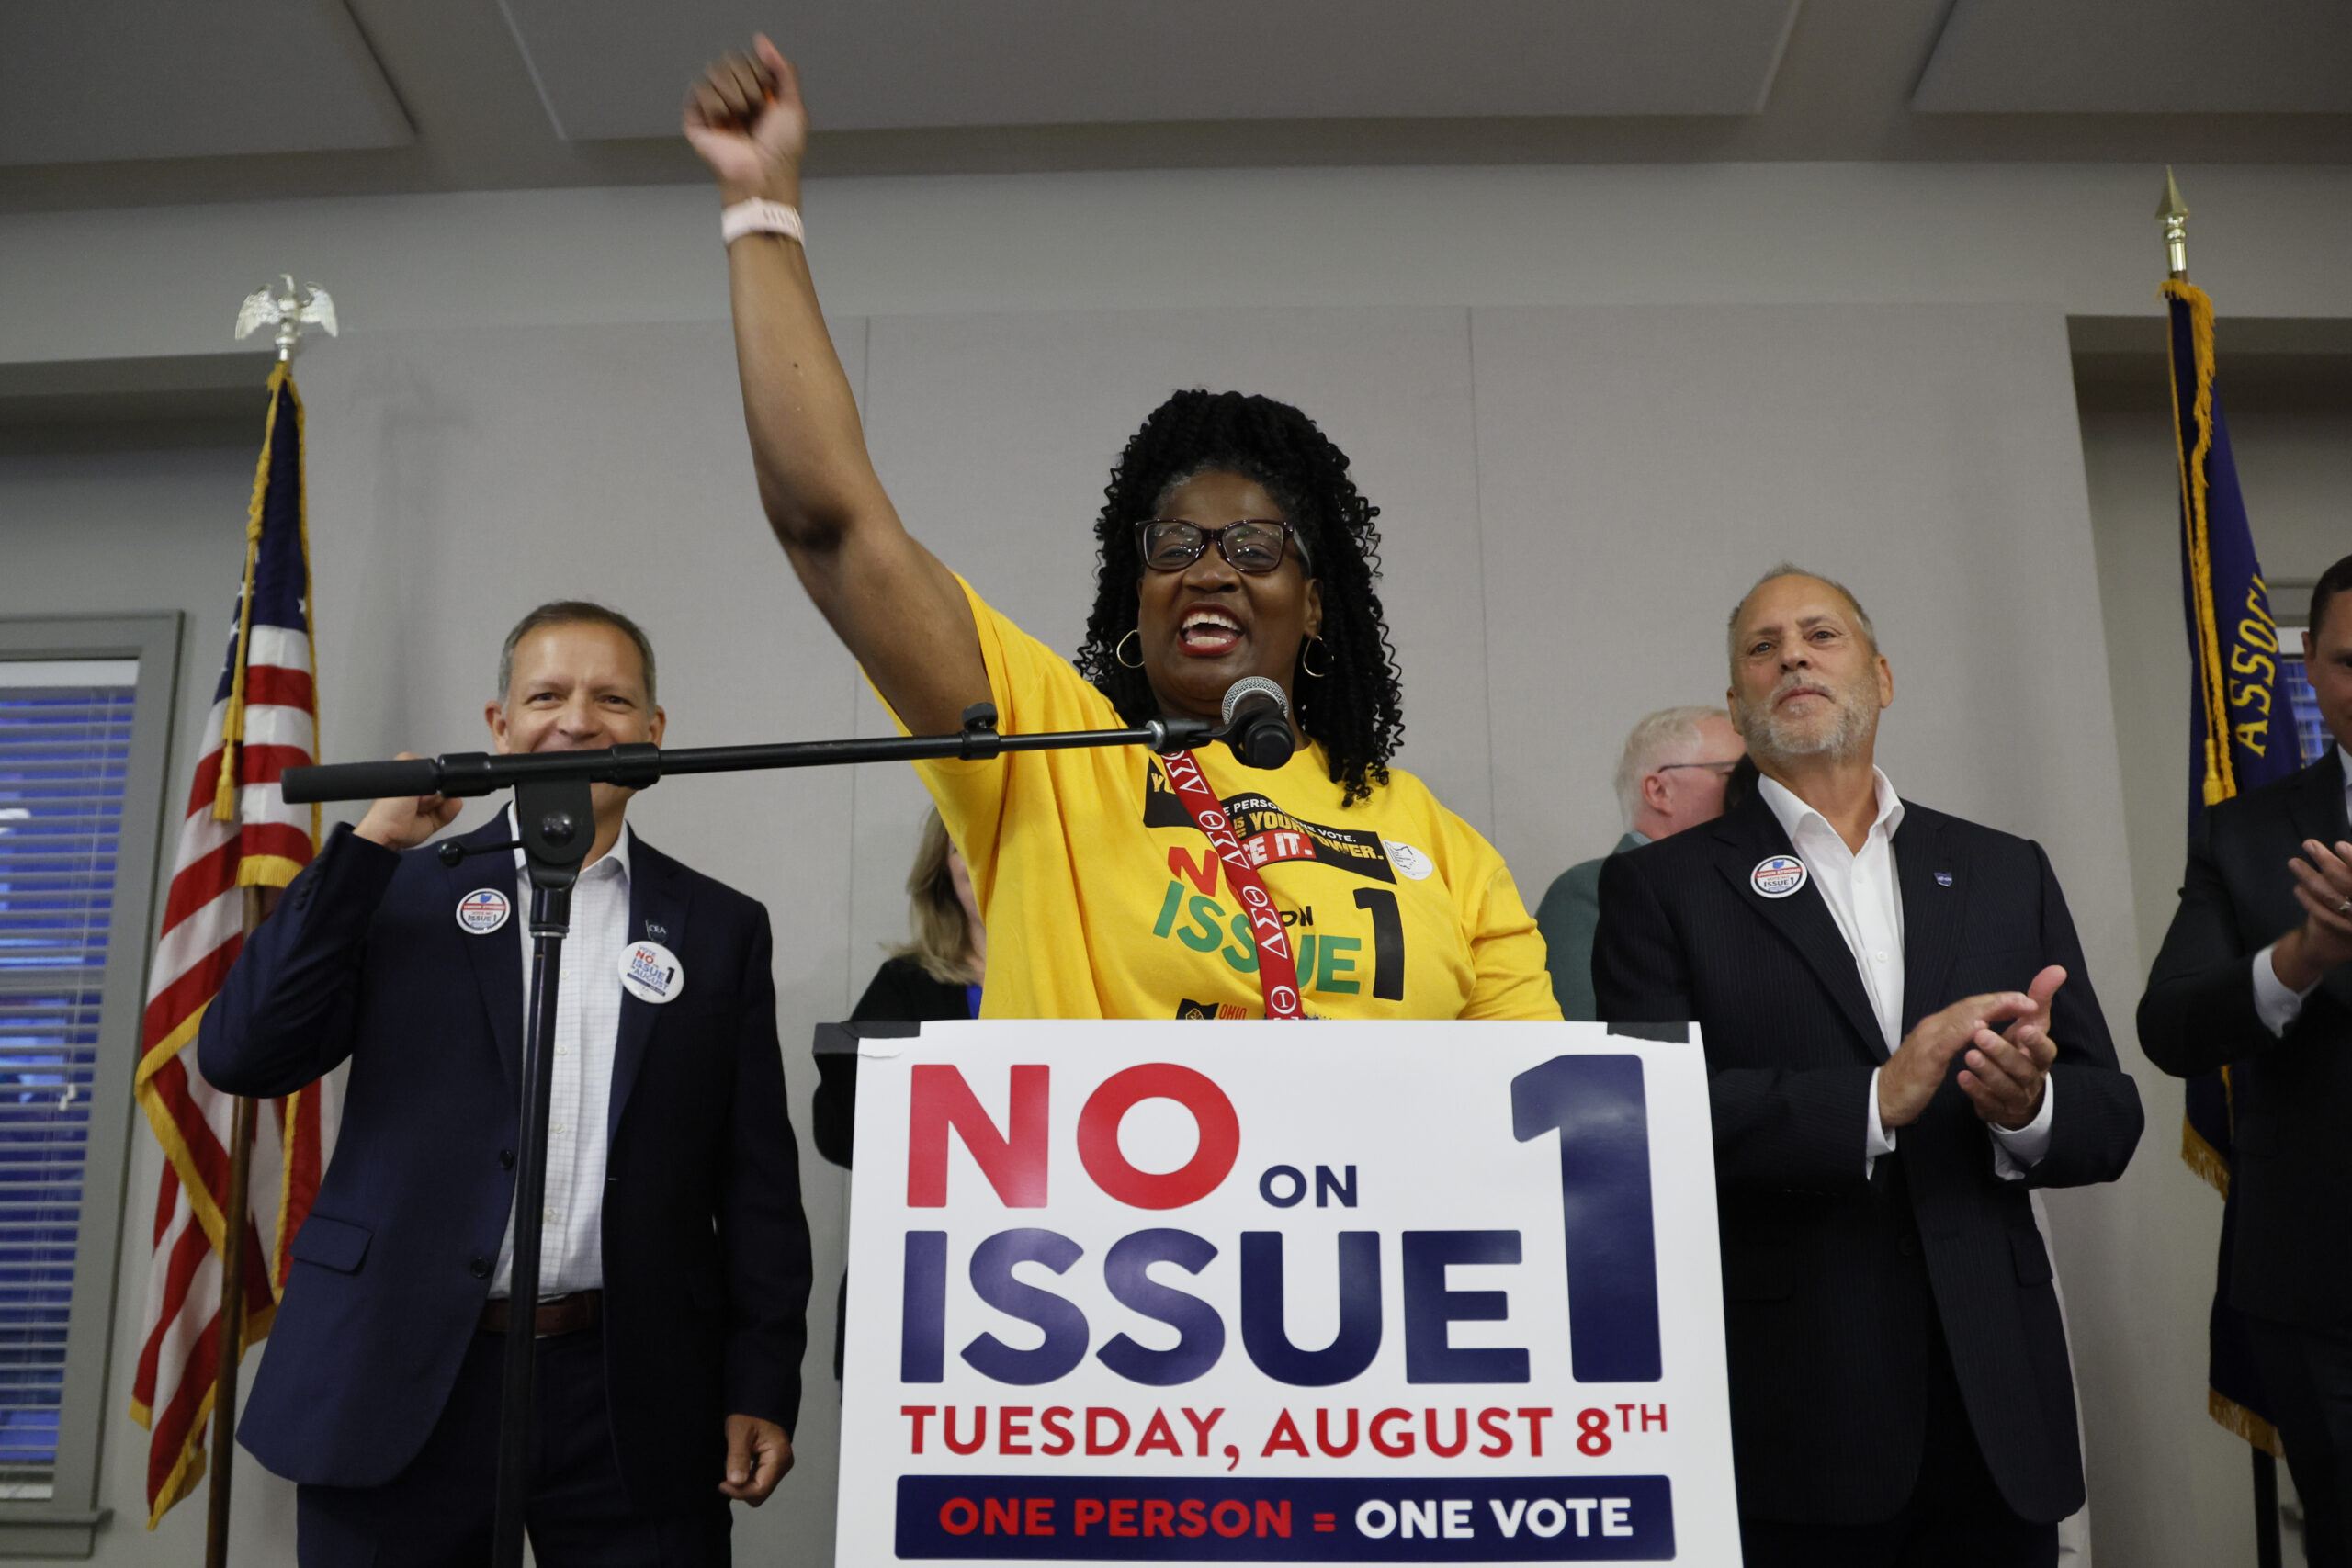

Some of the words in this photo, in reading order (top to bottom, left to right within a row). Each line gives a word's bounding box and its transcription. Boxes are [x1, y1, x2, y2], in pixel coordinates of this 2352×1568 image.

[1274, 831, 1313, 858] IT.
[1317, 829, 1357, 843] VOTE.
[636, 949, 655, 964] NO
[1353, 887, 1405, 1001] 1
[631, 957, 666, 982] ISSUE
[667, 966, 675, 985] 1
[907, 1062, 1240, 1210] NO
[1259, 1164, 1358, 1209] ON
[900, 1228, 1531, 1386] ISSUE
[1510, 1055, 1663, 1383] 1
[901, 1405, 1240, 1472] TUESDAY,
[1261, 1407, 1554, 1458] AUGUST
[940, 1497, 1056, 1537] ONE
[1075, 1498, 1292, 1539] PERSON
[1355, 1499, 1475, 1539] ONE
[1488, 1497, 1634, 1539] VOTE
